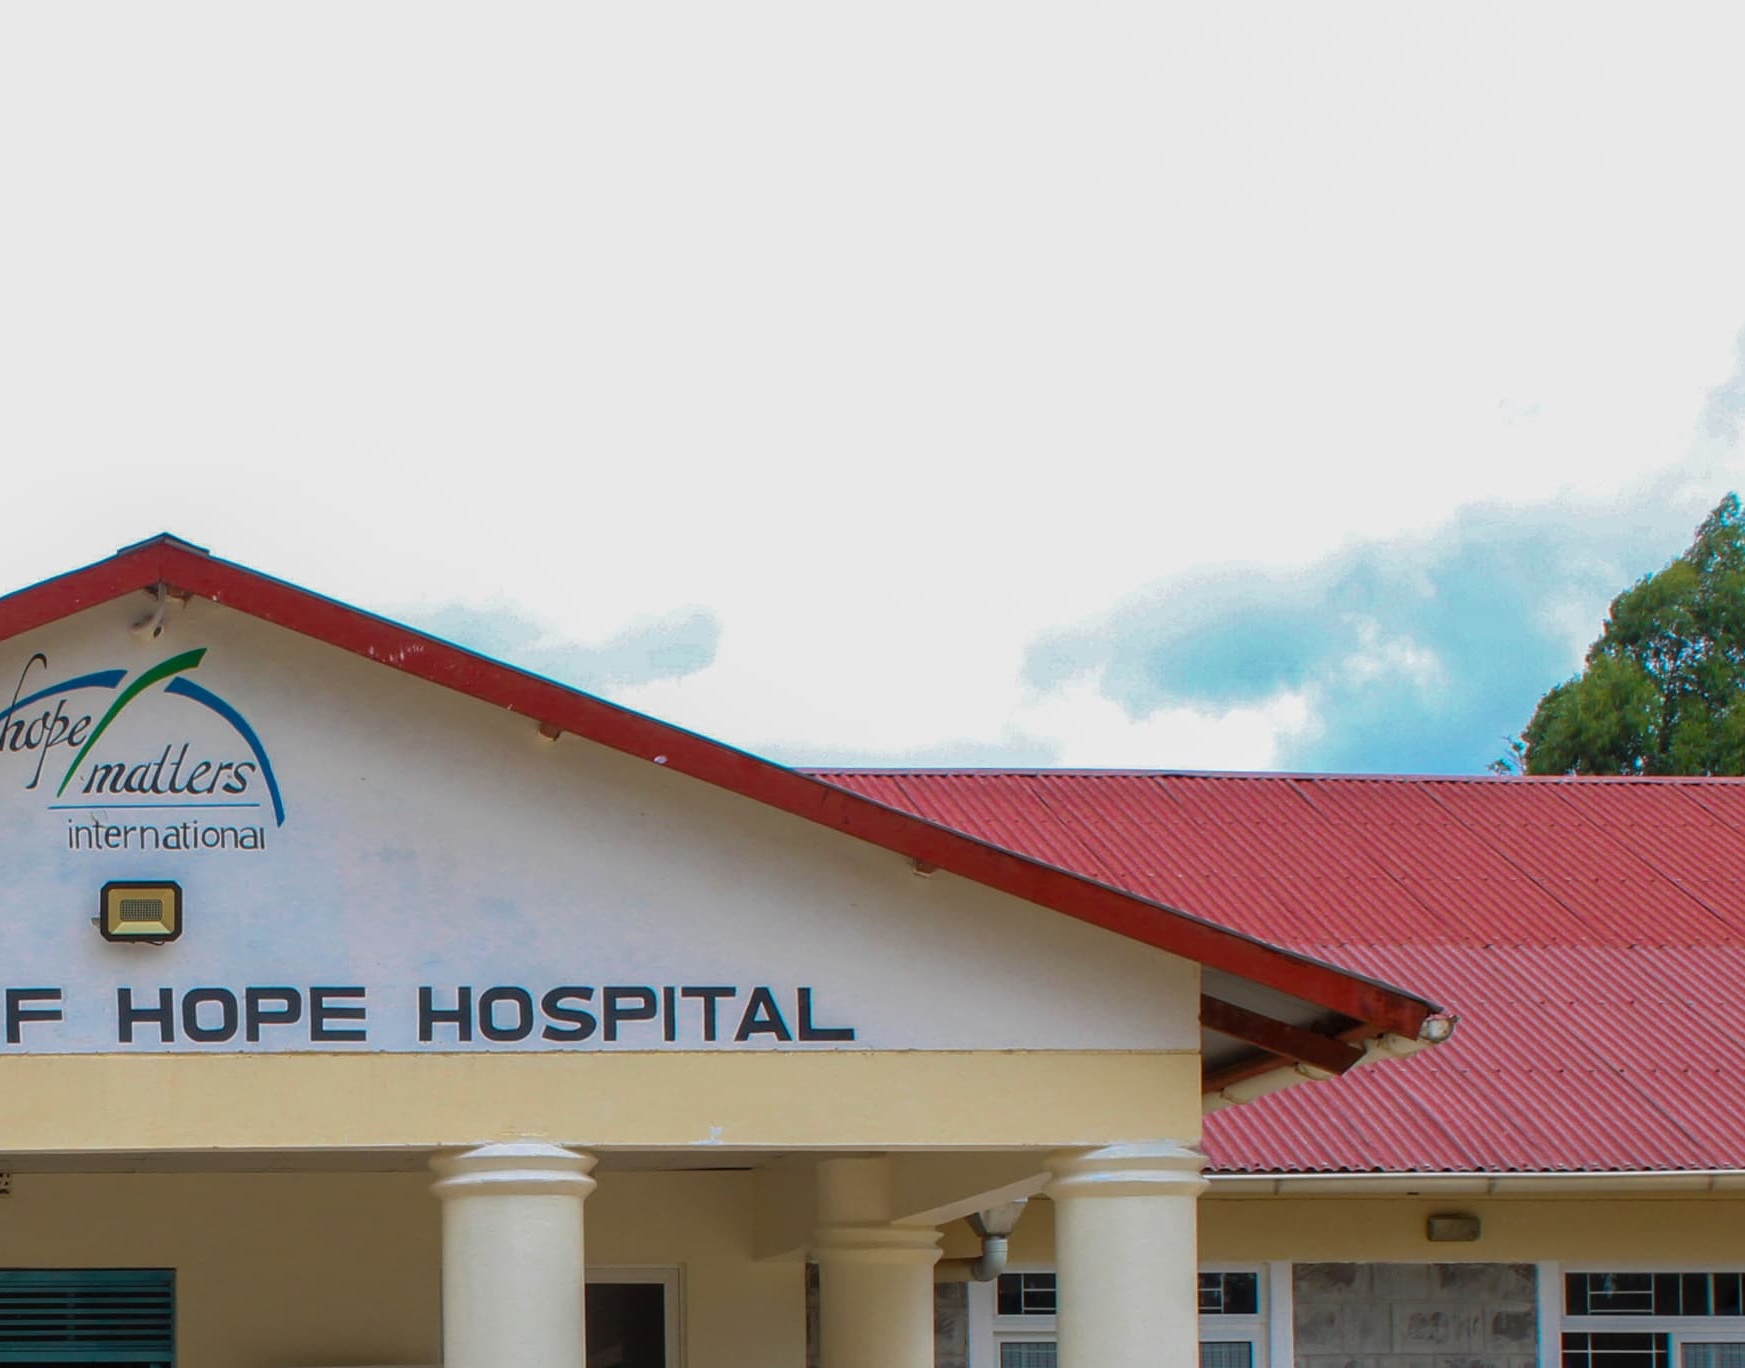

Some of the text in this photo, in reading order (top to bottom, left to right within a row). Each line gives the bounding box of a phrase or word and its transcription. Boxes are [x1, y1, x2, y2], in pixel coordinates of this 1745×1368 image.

[82, 743, 256, 795] matters
[67, 819, 266, 850] international
[118, 986, 367, 1043] HOPE
[418, 986, 855, 1043] HOSPITAL
